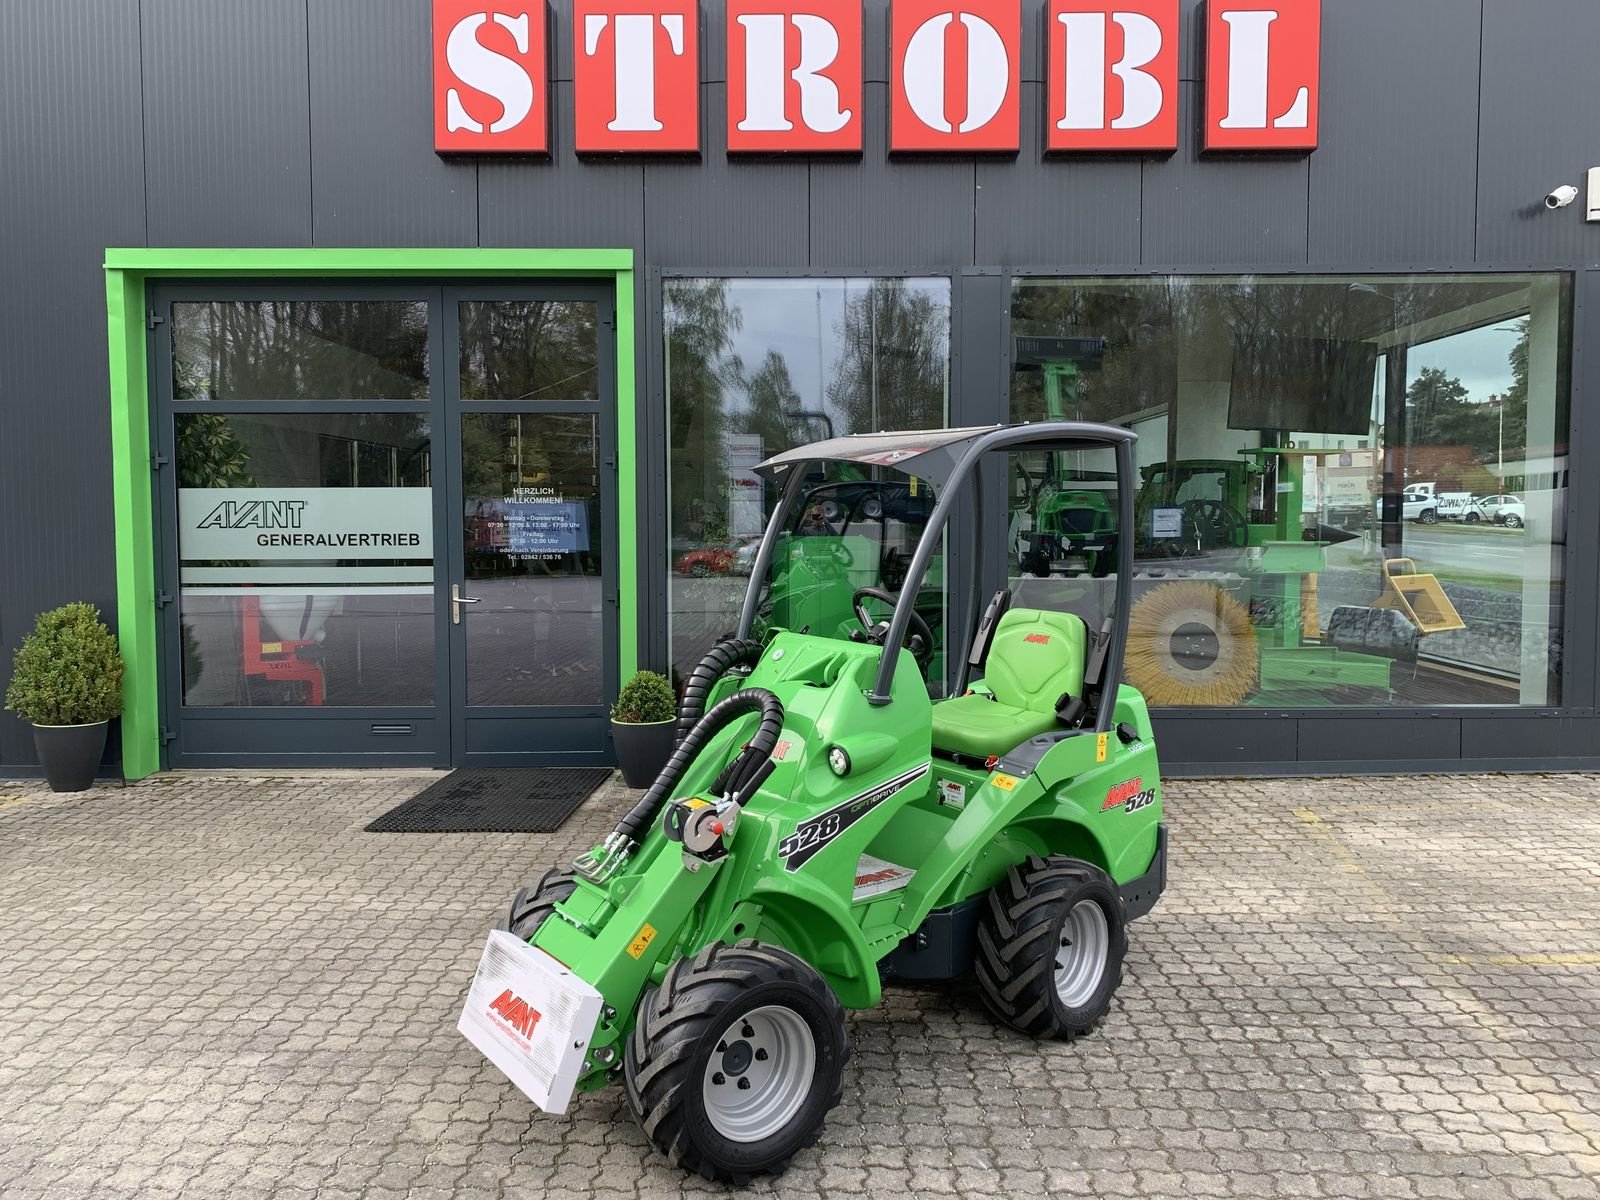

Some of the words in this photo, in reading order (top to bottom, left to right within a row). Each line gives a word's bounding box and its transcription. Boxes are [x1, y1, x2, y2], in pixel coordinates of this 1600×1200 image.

[446, 8, 1309, 135] STROBL
[503, 496, 563, 505] WILLKOMMEN!
[513, 487, 554, 495] HERZLICH
[257, 533, 420, 547] GENERALVERTRIEB
[1124, 788, 1156, 814] 528
[778, 813, 841, 859] 528
[489, 988, 542, 1041] AVANT
